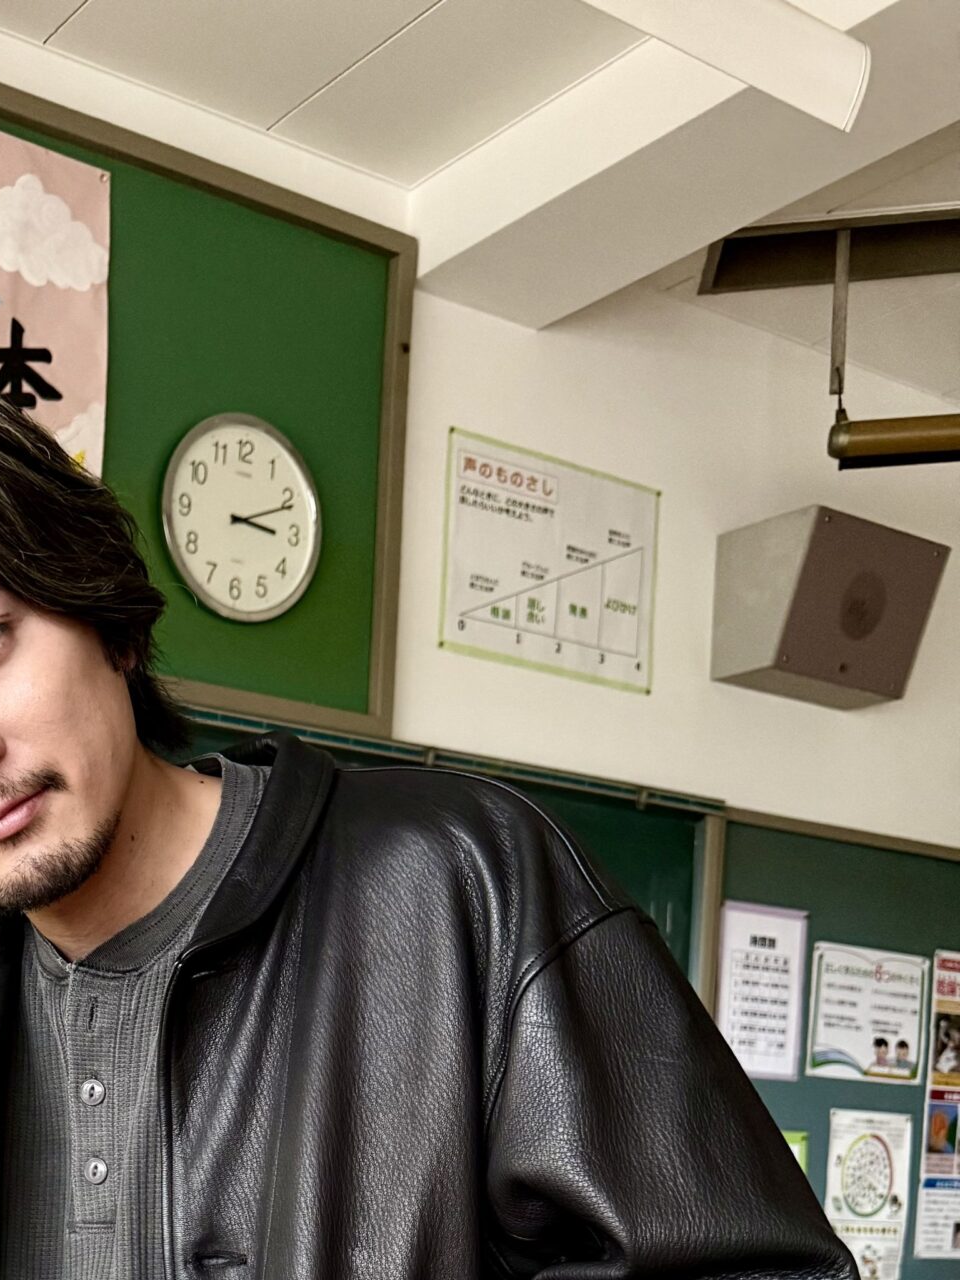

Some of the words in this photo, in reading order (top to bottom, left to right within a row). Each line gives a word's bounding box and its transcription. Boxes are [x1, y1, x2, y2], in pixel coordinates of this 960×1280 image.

[212, 440, 228, 466] 11
[237, 439, 255, 465] 12
[189, 459, 209, 486] 10
[269, 458, 276, 481] 1
[463, 456, 554, 497] 声のものさし
[178, 492, 192, 517] 9
[281, 486, 294, 509] 2
[185, 530, 199, 555] 8
[287, 524, 301, 548] 3
[205, 560, 218, 585] 7
[275, 557, 287, 579] 4
[229, 577, 242, 600] 6
[255, 574, 269, 598] 5
